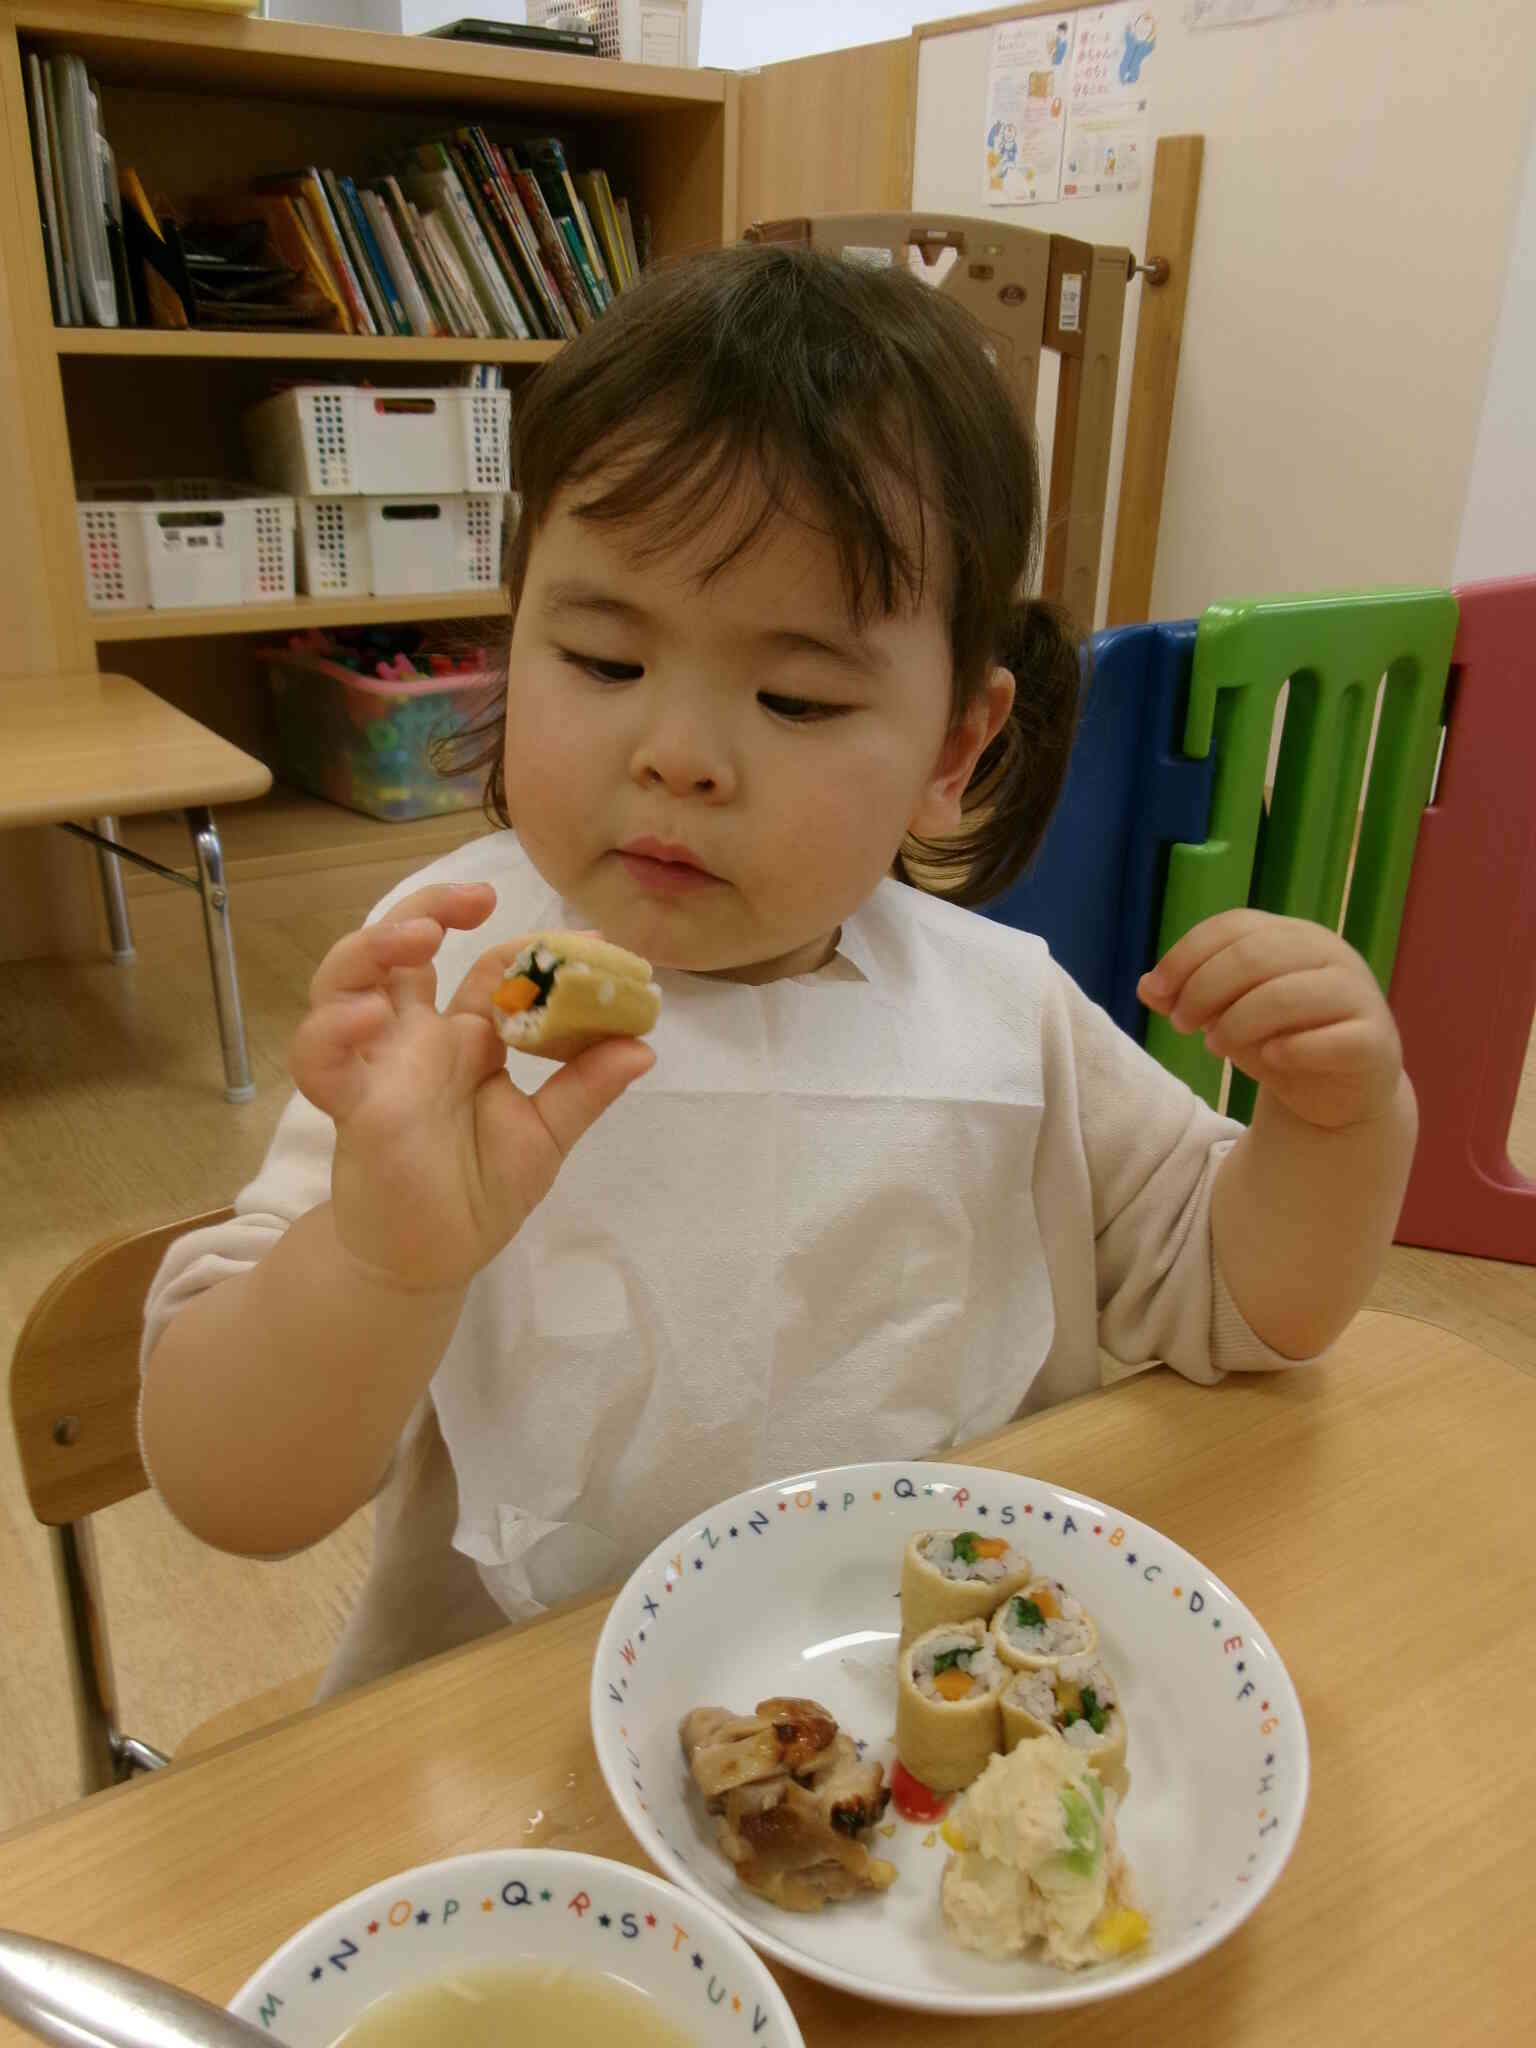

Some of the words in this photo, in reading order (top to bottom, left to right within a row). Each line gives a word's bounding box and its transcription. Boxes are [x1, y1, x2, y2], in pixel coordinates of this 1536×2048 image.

[643, 1595, 659, 1618] X
[795, 1490, 812, 1509] O
[843, 1493, 854, 1511] P
[894, 1479, 917, 1498] Q
[953, 1488, 970, 1508] R
[1001, 1506, 1015, 1525] S
[1063, 1516, 1077, 1534] A
[1109, 1528, 1125, 1547] B
[1144, 1566, 1162, 1582] C
[1190, 1591, 1204, 1613] D
[388, 1900, 412, 1926] O
[443, 1899, 459, 1924] P
[502, 1881, 532, 1906] Q
[568, 1892, 590, 1917] R
[621, 1913, 639, 1938] S
[672, 1924, 688, 1952] T
[707, 1976, 726, 2005] U
